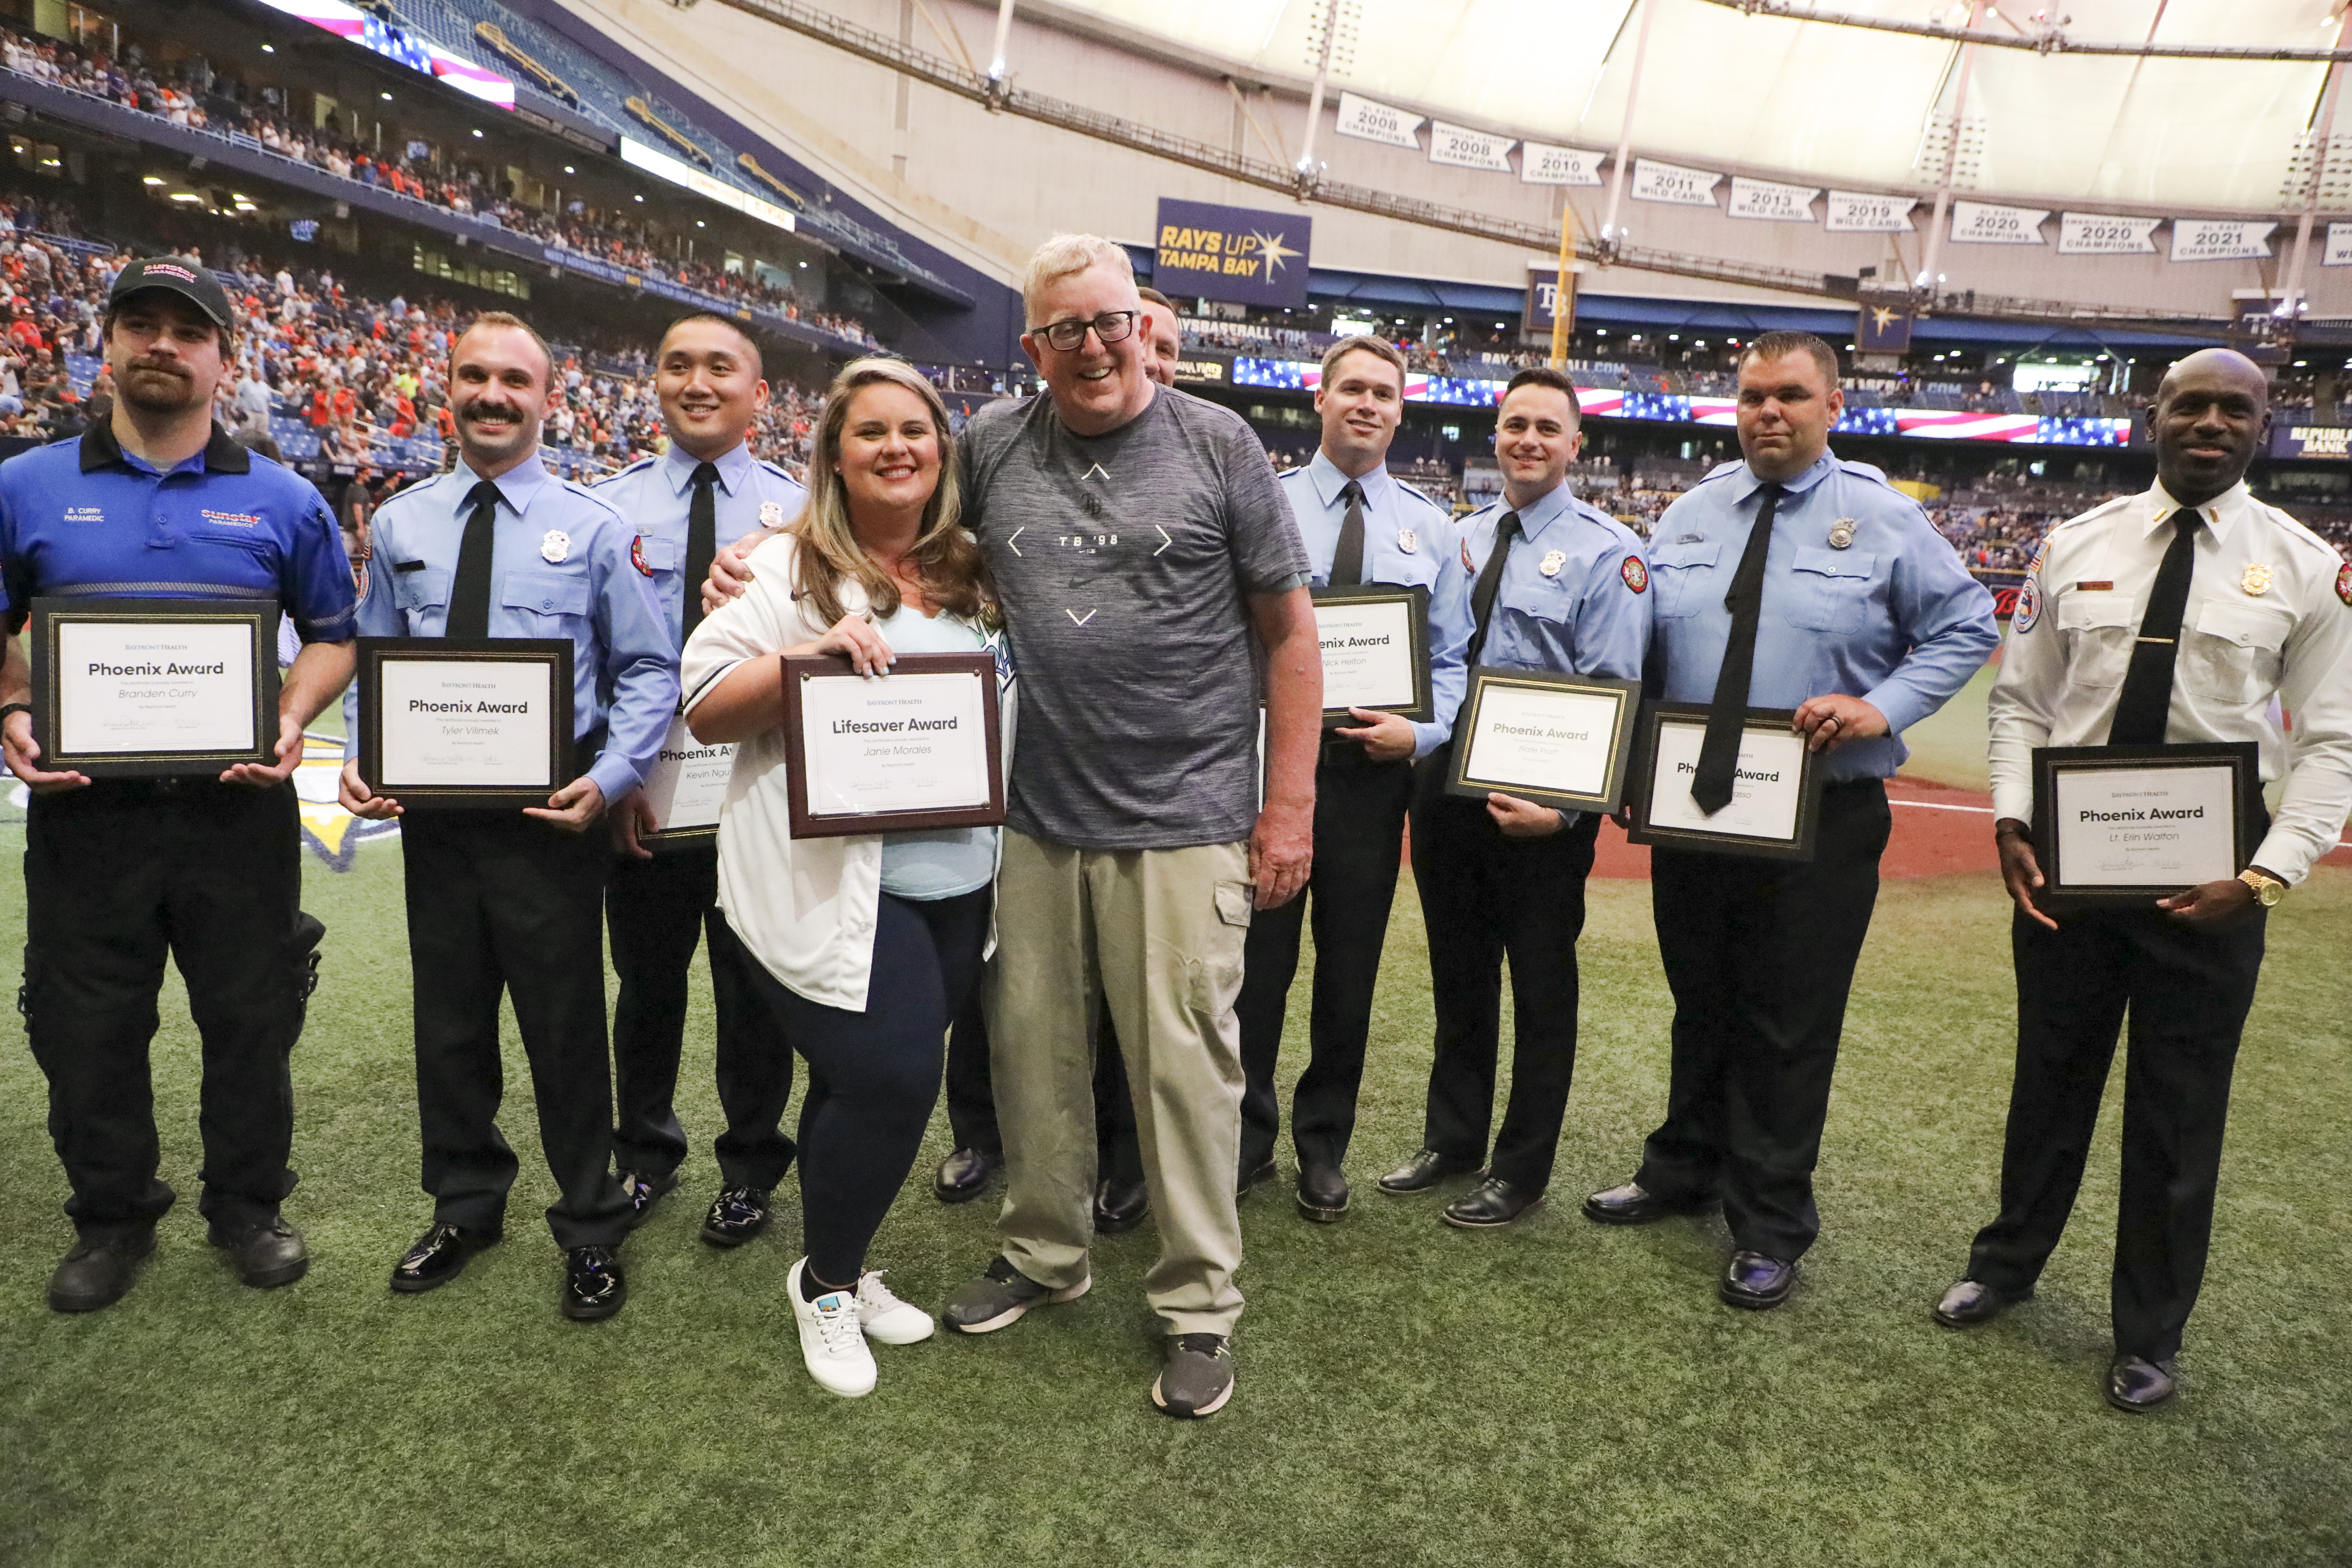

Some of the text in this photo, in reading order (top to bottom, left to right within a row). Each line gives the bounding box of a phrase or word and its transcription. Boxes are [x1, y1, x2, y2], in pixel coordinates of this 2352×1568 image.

[1359, 112, 1397, 131] 2008
[1345, 121, 1406, 143] CHAMPIONS
[1450, 138, 1489, 156] 2008
[1436, 149, 1500, 166] CHAMPIONS
[1542, 158, 1580, 172] 2010
[1530, 169, 1589, 182] CHAMPIONS
[1656, 175, 1693, 190] 2011
[1640, 185, 1704, 202] WILD CARD
[1751, 192, 1791, 206] 2013
[1738, 203, 1803, 217] WILD CARD
[1848, 204, 1890, 218] 2019
[1835, 217, 1864, 225] WILD
[1975, 217, 2019, 230] 2020
[1961, 228, 2030, 240] CHAMPIONS
[2082, 227, 2132, 240] 2020
[2196, 232, 2242, 245] 2021
[1160, 225, 1258, 257] RAYS UP
[2067, 239, 2143, 249] CHAMPIONS
[2179, 246, 2259, 256] CHAMPIONS
[1159, 249, 1260, 277] TAMPA BAY
[1179, 317, 1273, 341] AYSBASEBALL
[2290, 427, 2352, 442] REPUBLI
[2302, 439, 2349, 454] BANK
[209, 518, 253, 528] PARAMEDICS
[1093, 534, 1118, 546] '98
[1319, 634, 1390, 649] enix Award
[89, 662, 224, 676] Phoenix Award
[1322, 658, 1367, 667] Nick Helton
[118, 689, 198, 699] Branden Curry
[409, 699, 528, 714] Phoenix Award
[442, 726, 499, 736] Tyler Vilimek
[832, 716, 958, 734] Lifesaver Award
[1493, 722, 1589, 741] Phoenix Award
[659, 746, 717, 762] Phoenix
[864, 745, 932, 757] Janie Morales
[1518, 745, 1559, 756] Nate Pratt
[687, 769, 731, 779] Kevin Ngu
[1734, 768, 1779, 782] Award
[2080, 806, 2204, 822] Phoenix Award
[2110, 832, 2180, 842] Lt. Erin Walton
